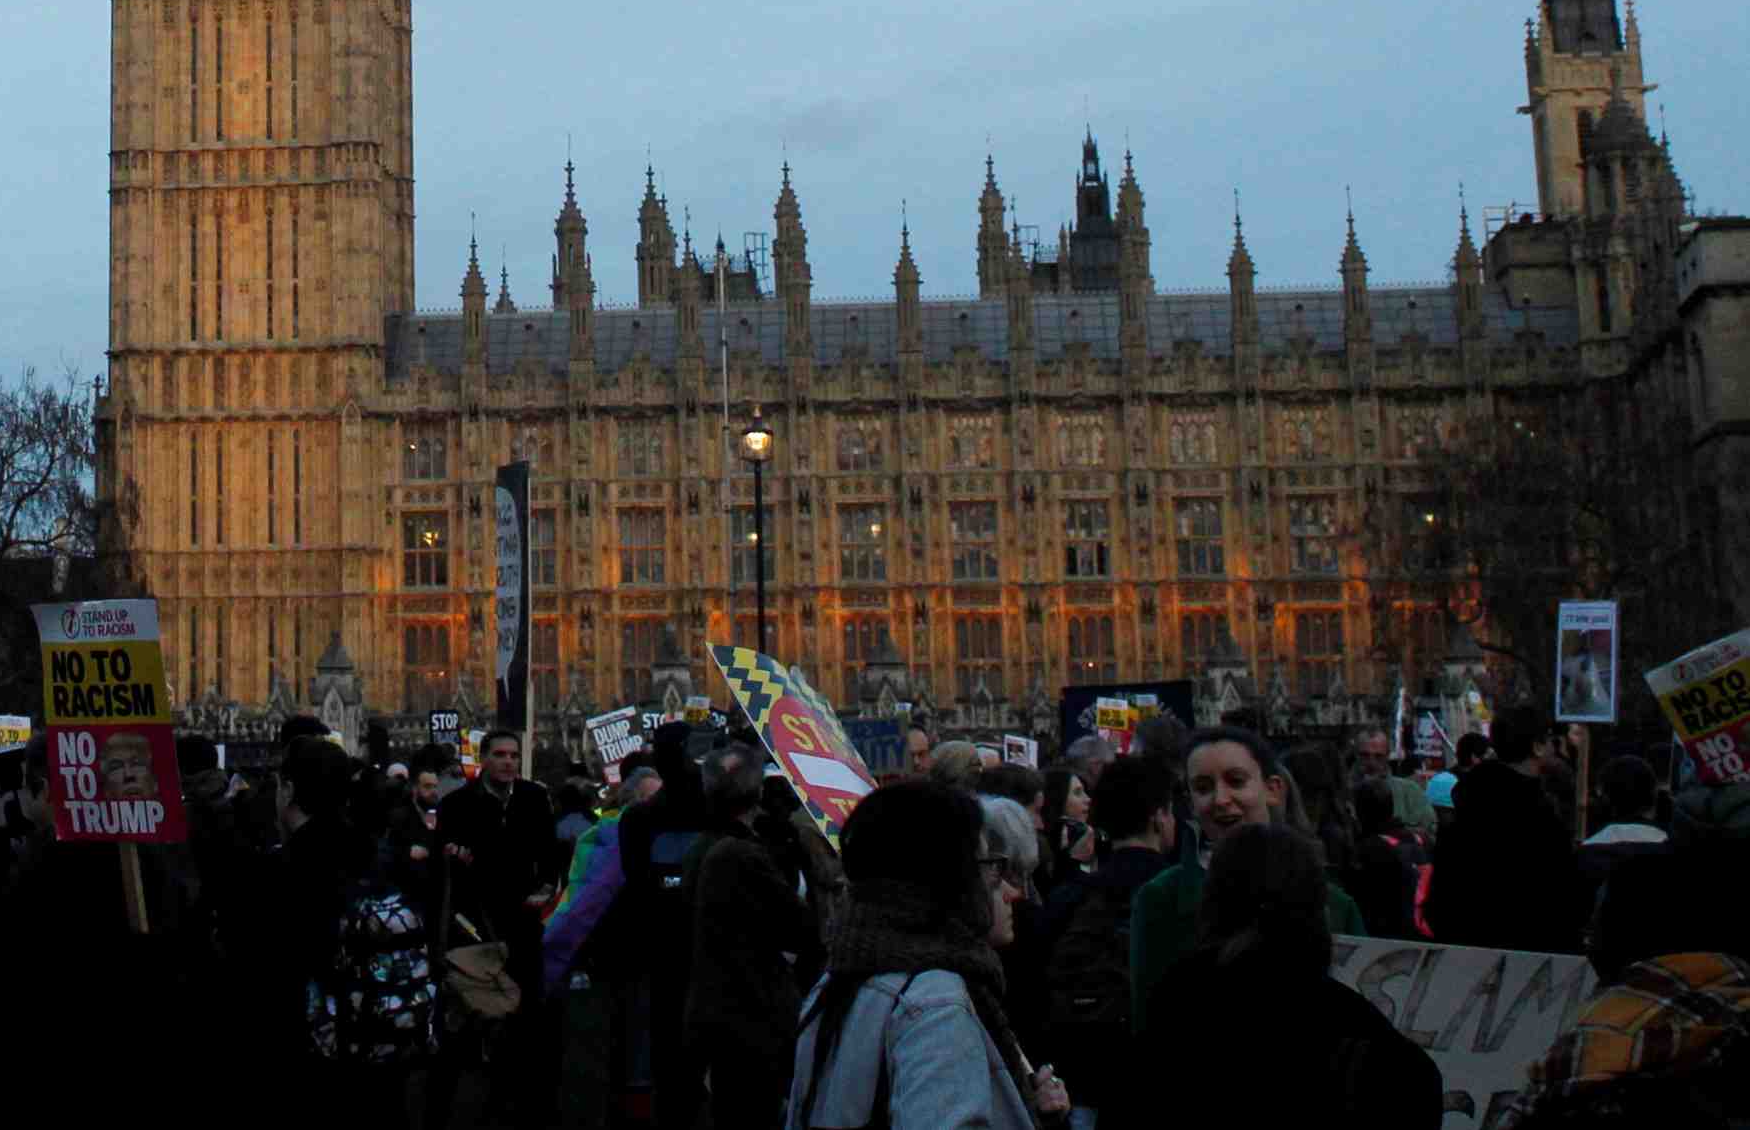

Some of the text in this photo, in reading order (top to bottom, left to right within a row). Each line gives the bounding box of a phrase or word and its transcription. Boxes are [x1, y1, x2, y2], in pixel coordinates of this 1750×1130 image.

[81, 609, 128, 622] STAND UP
[82, 624, 135, 636] TO RACISM
[52, 649, 131, 683] NO TO
[53, 684, 155, 717] RACISM
[1673, 670, 1744, 710] NO TO
[431, 713, 458, 730] STOP
[1682, 696, 1750, 728] RACIS
[593, 719, 630, 745] DUMP
[1695, 732, 1735, 757] NO
[57, 731, 96, 765] NO
[599, 735, 643, 764] TRUMP
[1706, 752, 1744, 776] TO
[58, 766, 97, 799] TO
[63, 800, 165, 834] TRUMP
